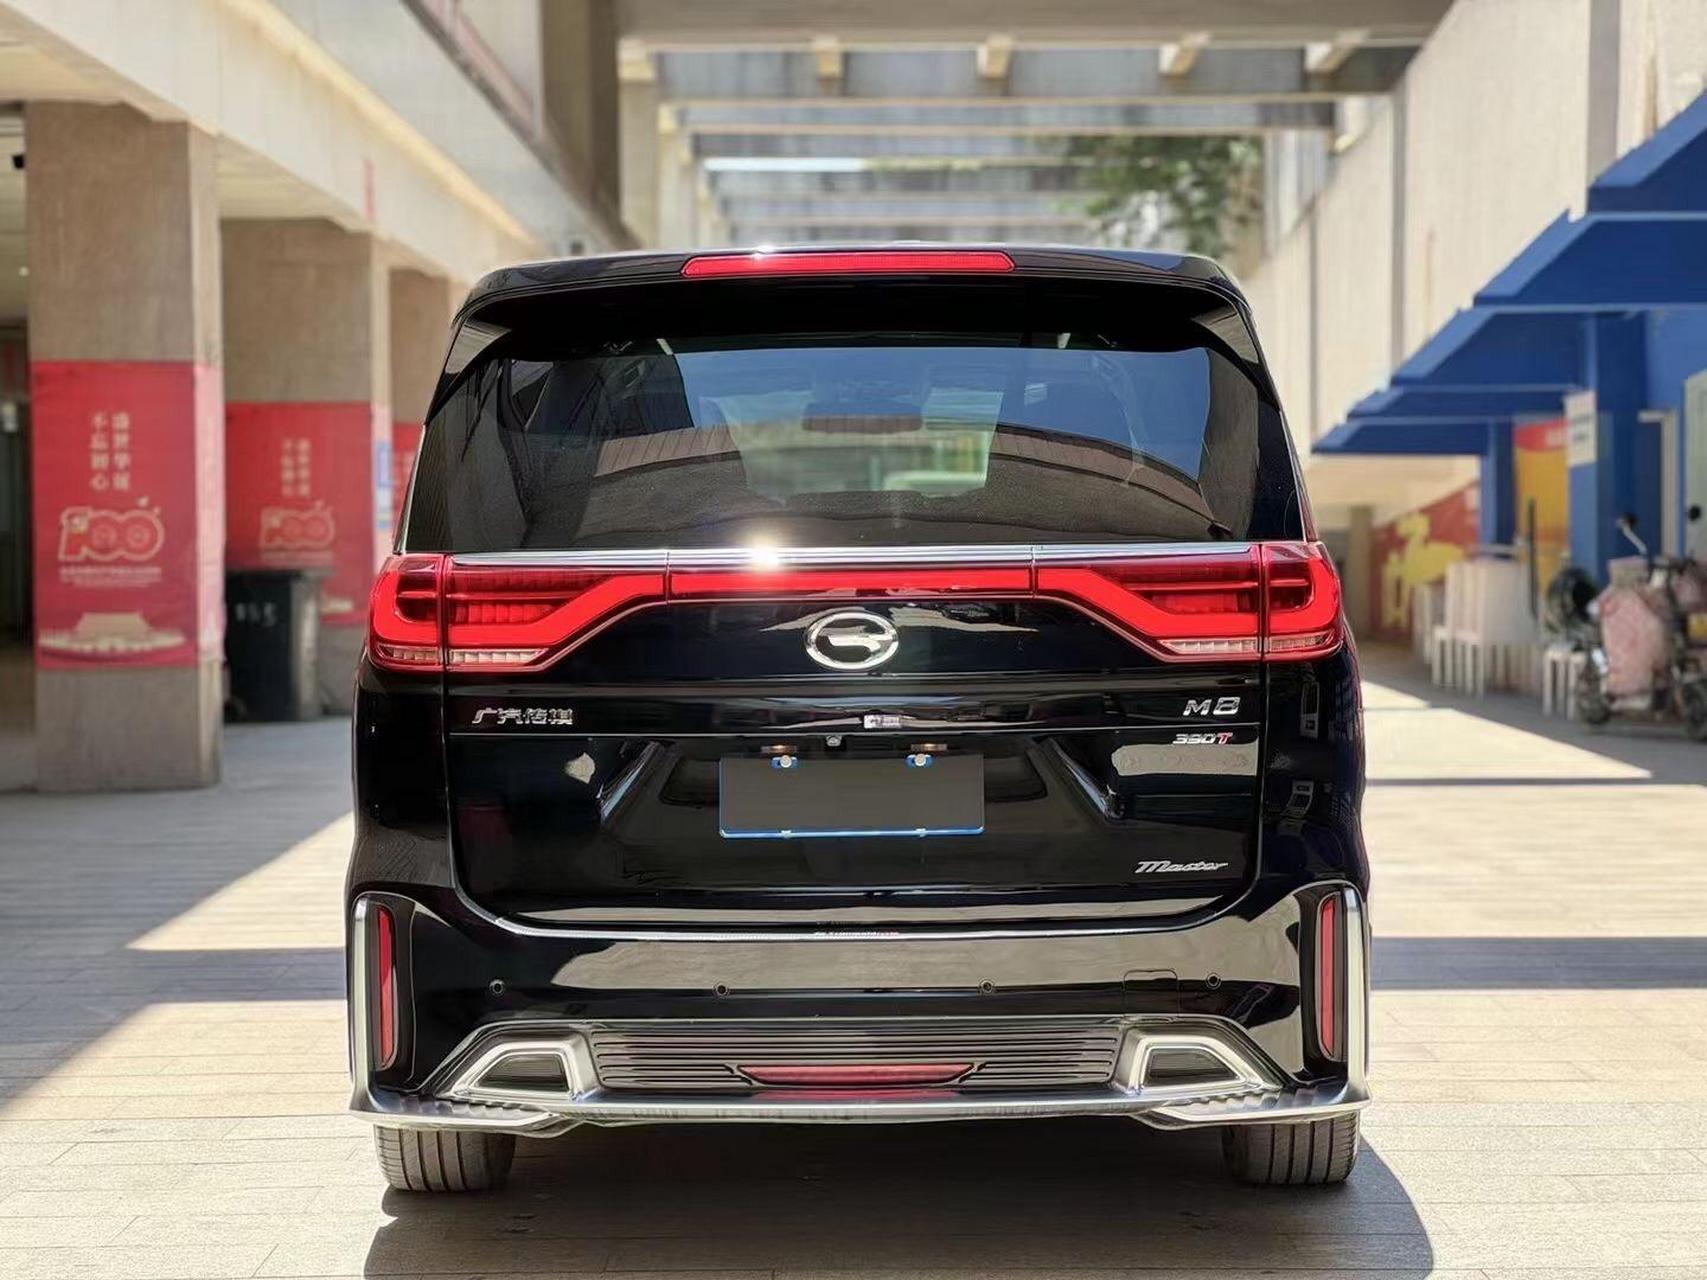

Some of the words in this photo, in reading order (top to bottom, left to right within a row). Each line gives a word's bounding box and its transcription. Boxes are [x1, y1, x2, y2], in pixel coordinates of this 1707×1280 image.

[1182, 696, 1241, 716] M8
[471, 707, 573, 725] 广汽传祺
[1135, 860, 1229, 874] Master
